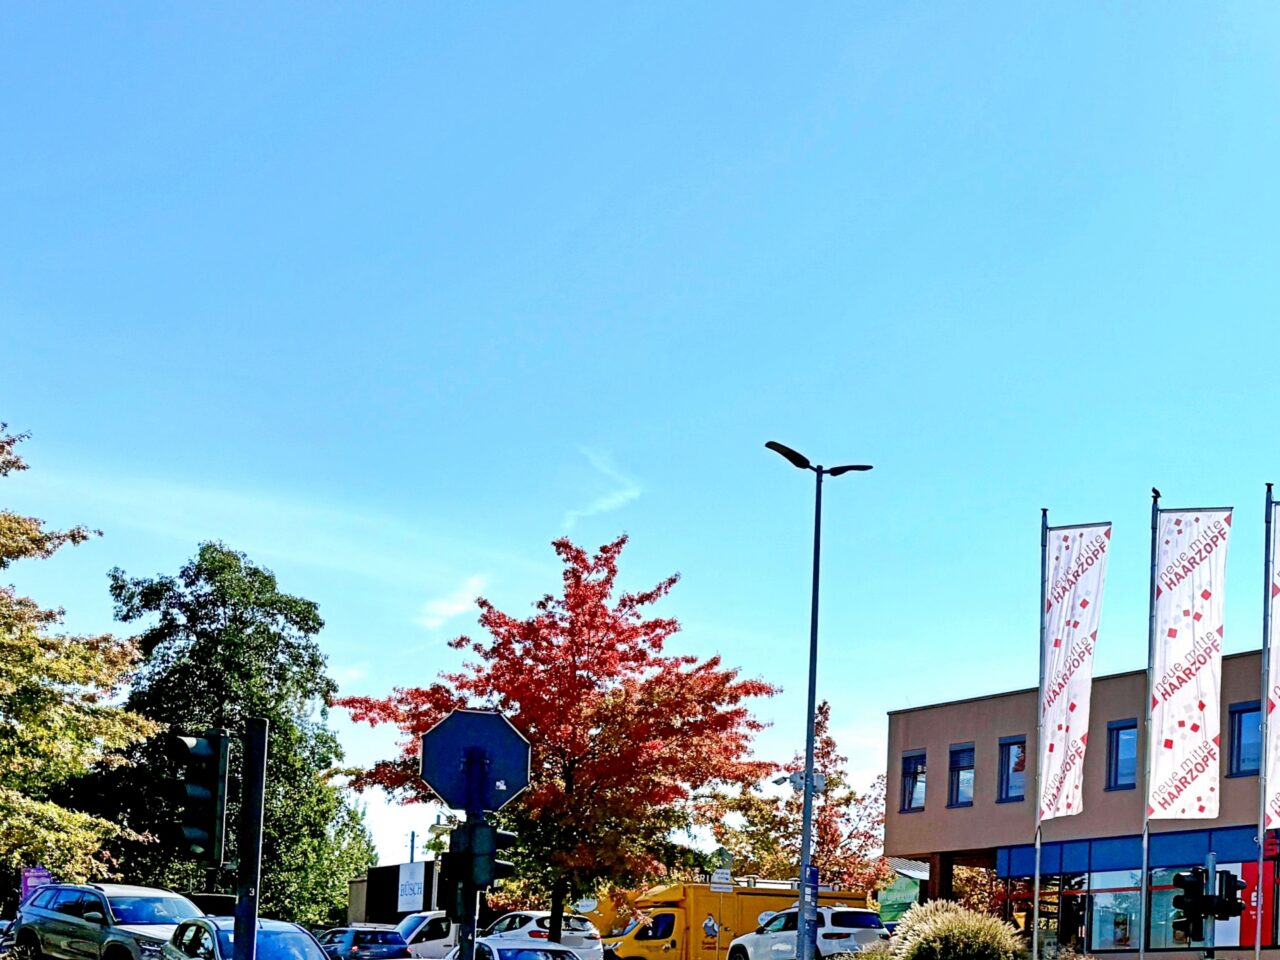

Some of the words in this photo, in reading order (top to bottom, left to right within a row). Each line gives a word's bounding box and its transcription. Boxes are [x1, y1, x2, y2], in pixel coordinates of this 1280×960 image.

[1053, 541, 1107, 604] HAARZOPF
[1160, 552, 1188, 582] neue
[1189, 520, 1222, 552] mitte
[1165, 527, 1227, 591] HAARZOPF
[1046, 643, 1093, 708] HAARZOPF
[1155, 662, 1183, 693] neue
[1161, 639, 1220, 702] HAARZOPF
[1152, 771, 1179, 801] neue
[1180, 740, 1211, 772] mitte
[1158, 748, 1217, 811] HAARZOPF
[400, 881, 423, 897] BÜSCH
